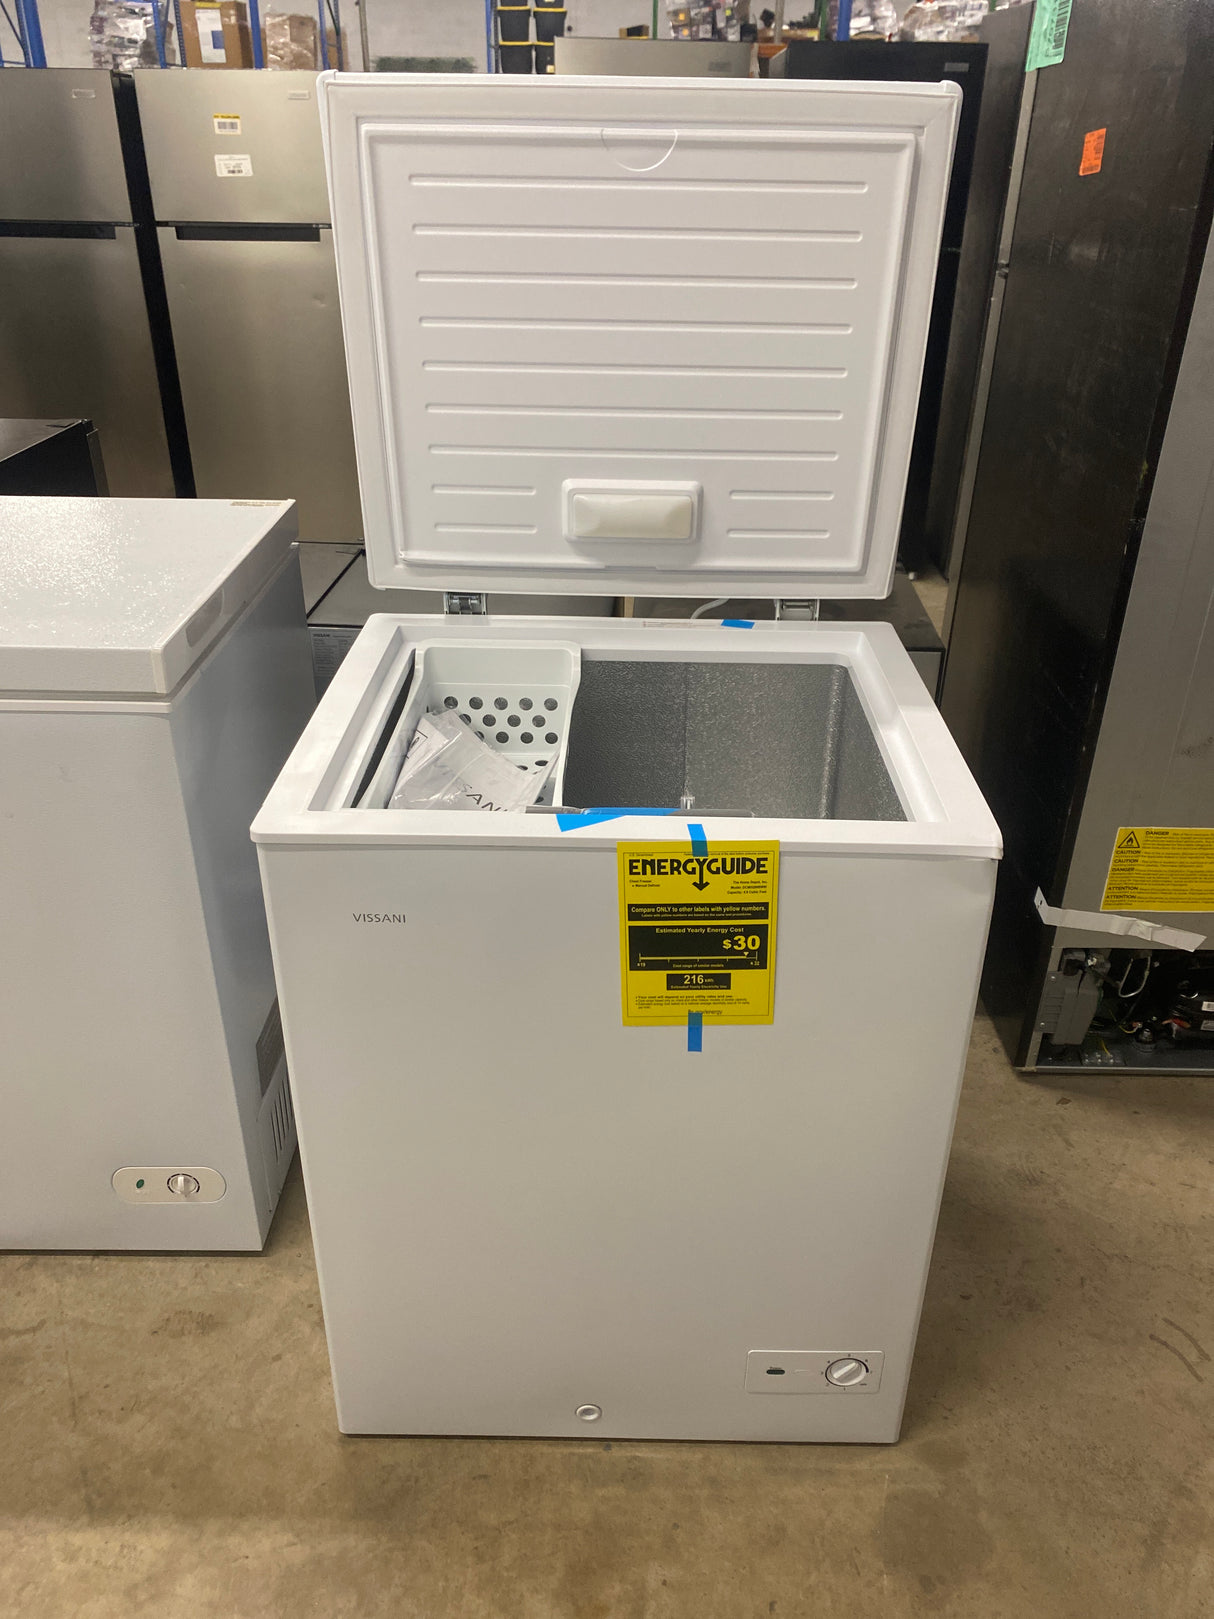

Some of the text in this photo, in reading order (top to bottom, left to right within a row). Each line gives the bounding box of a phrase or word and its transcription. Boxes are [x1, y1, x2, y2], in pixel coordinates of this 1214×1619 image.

[628, 857, 768, 879] ENERGYGUIDE
[631, 906, 655, 914] Compare
[723, 905, 740, 913] yellow
[352, 913, 406, 923] VISSANI
[722, 935, 760, 951] $30
[683, 974, 704, 985] 216
